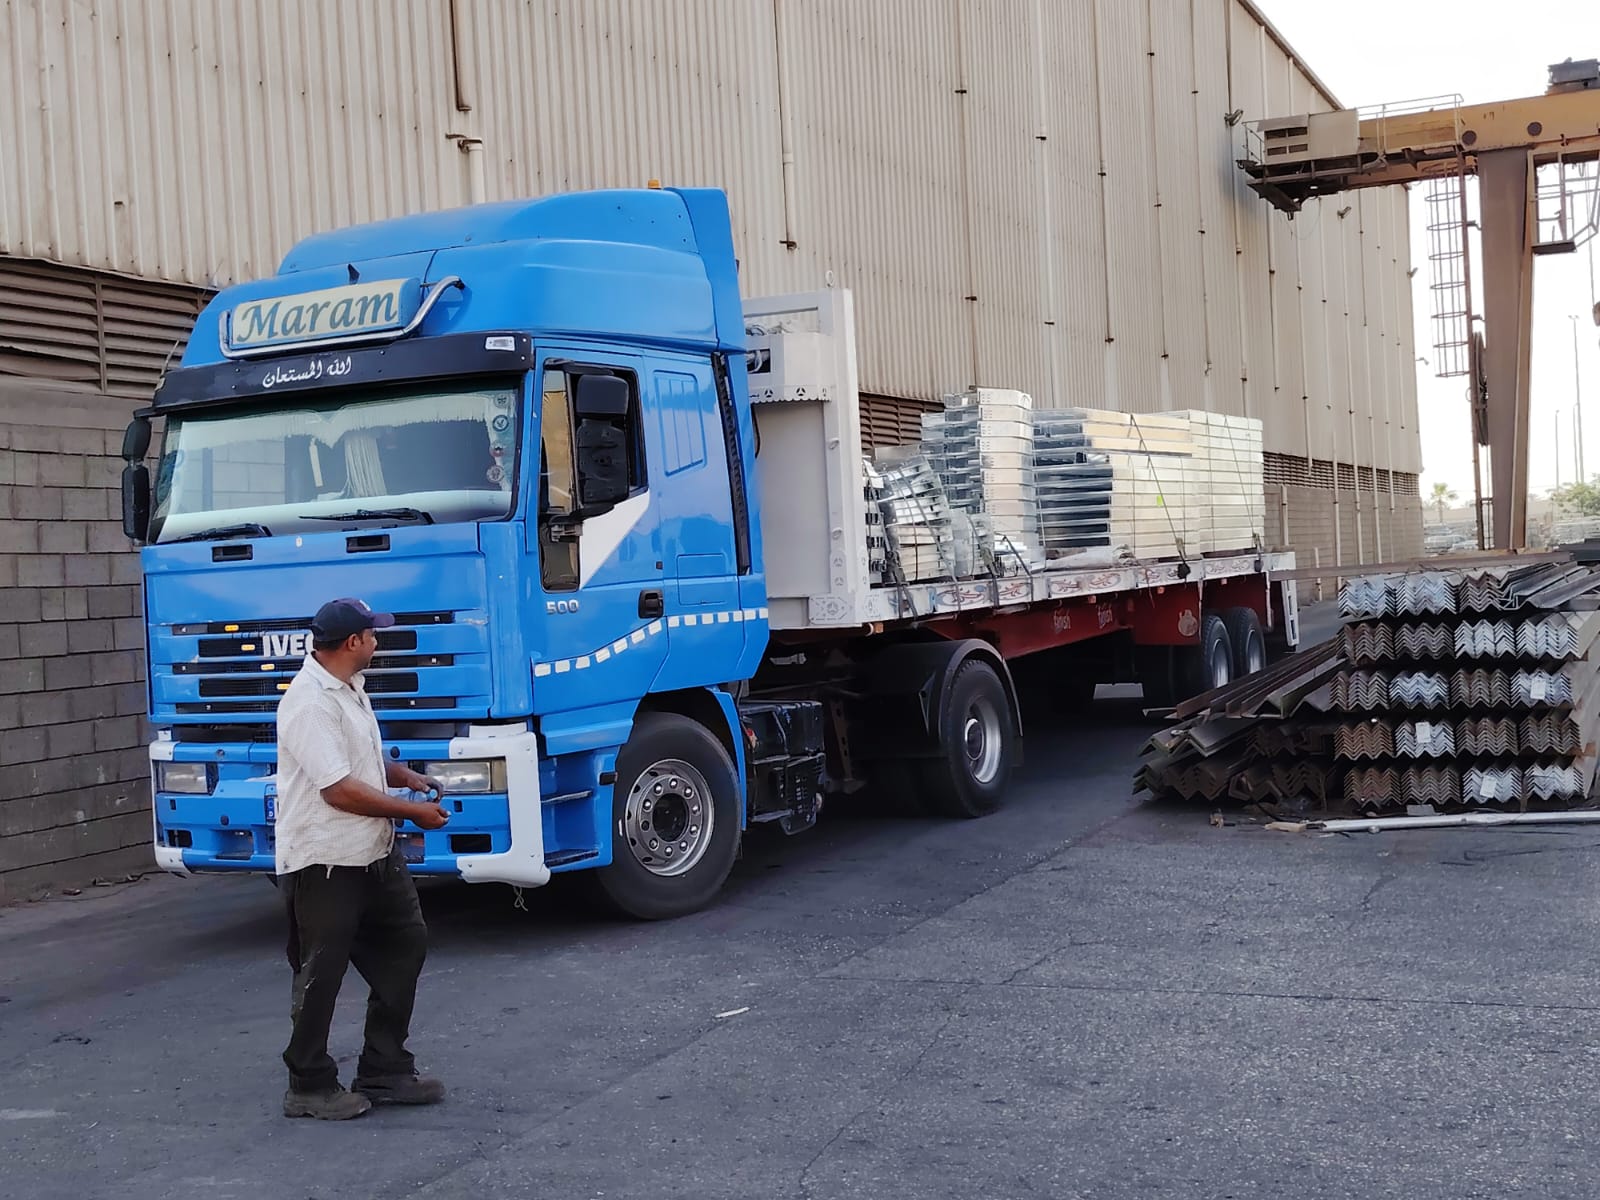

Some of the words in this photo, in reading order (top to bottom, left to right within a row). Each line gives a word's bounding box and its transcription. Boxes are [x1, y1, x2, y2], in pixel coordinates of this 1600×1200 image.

[237, 292, 398, 342] Maram
[262, 359, 323, 388] المستعان
[326, 355, 352, 376] الله
[546, 599, 579, 614] 500
[262, 633, 314, 657] IVE
